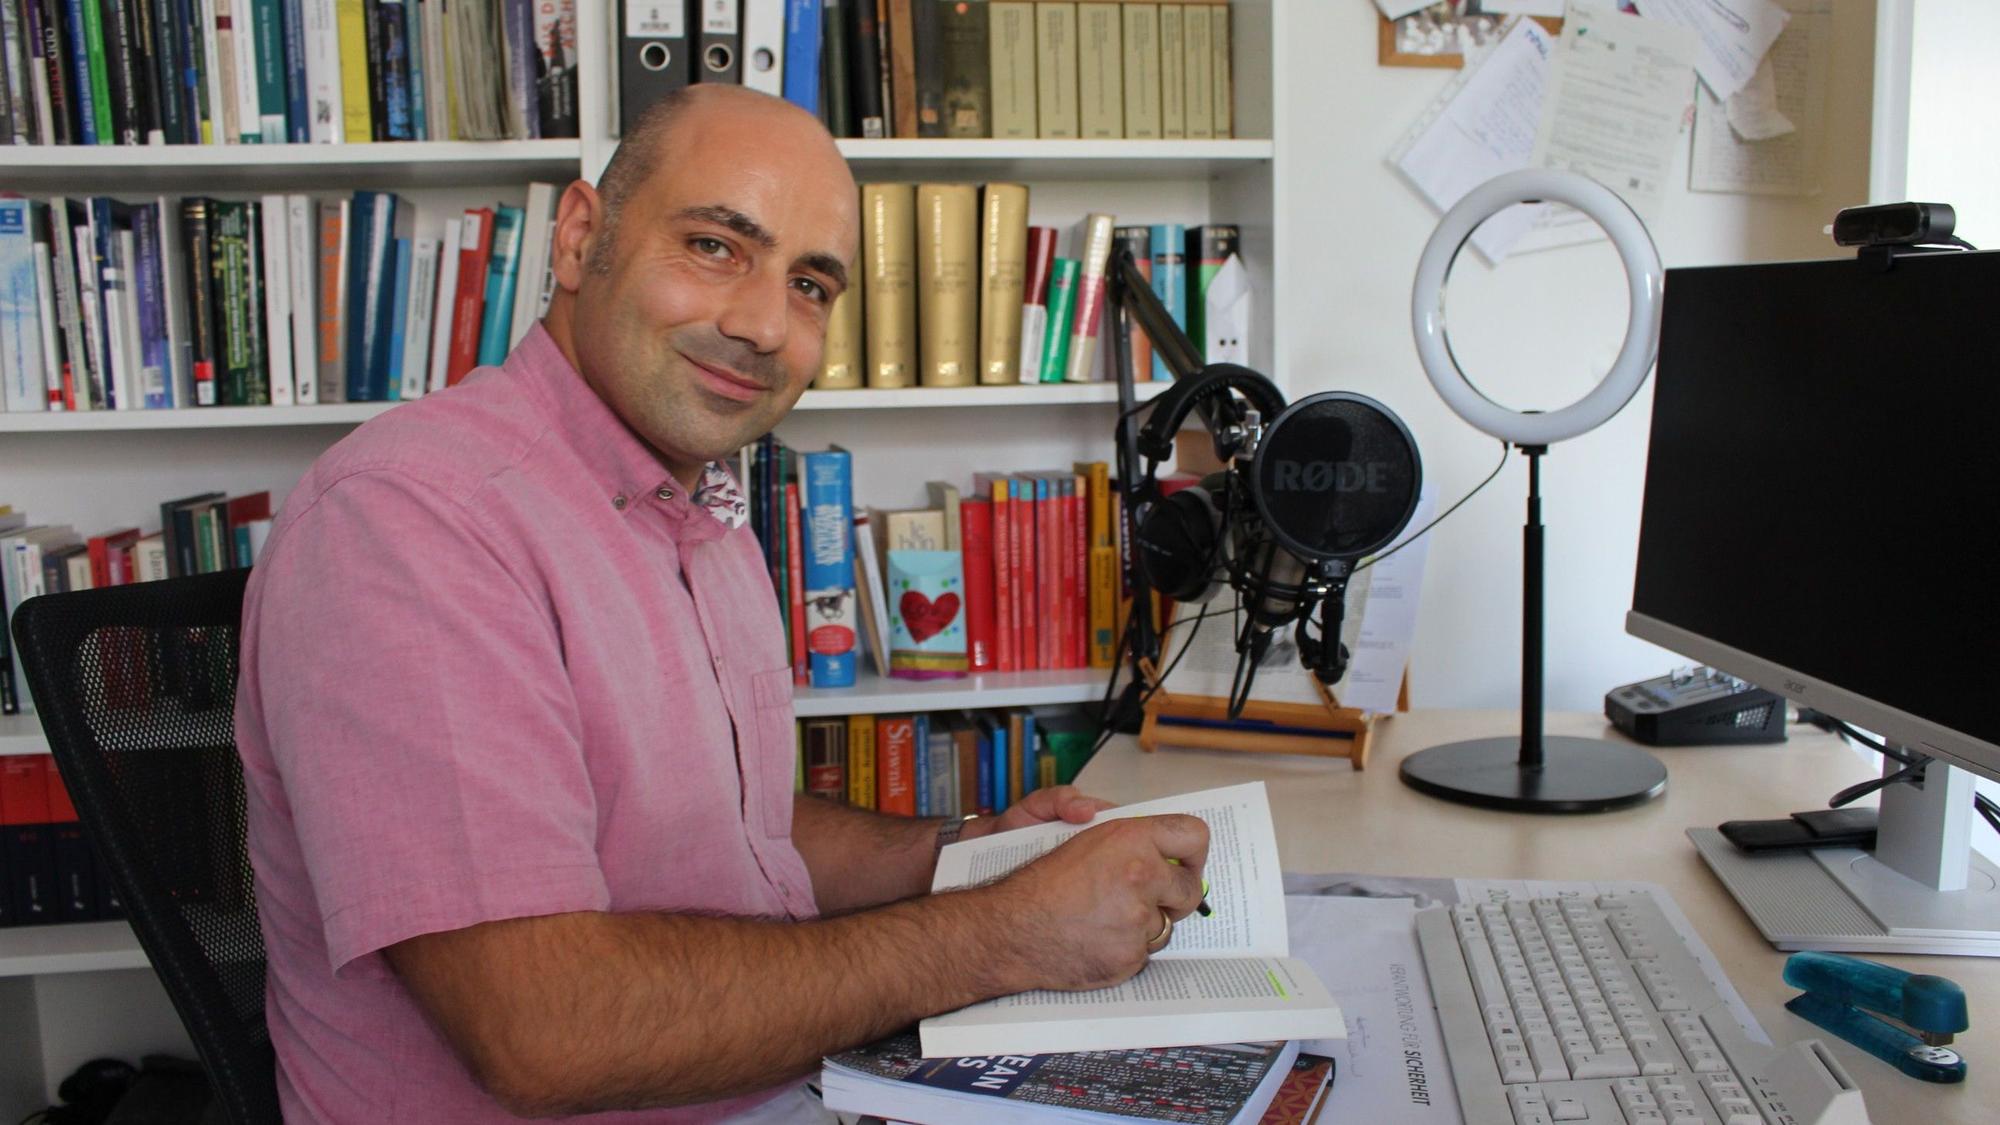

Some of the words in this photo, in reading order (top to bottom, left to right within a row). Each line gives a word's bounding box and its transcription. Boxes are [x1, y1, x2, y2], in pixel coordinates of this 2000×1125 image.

[1273, 460, 1388, 492] RØDE
[1784, 679, 1806, 694] acer
[1388, 962, 1417, 1033] VERANTWORTUNG
[1401, 1032, 1423, 1050] FÜR
[971, 1054, 1033, 1091] EAN
[1404, 1049, 1431, 1106] SICHERHEIT
